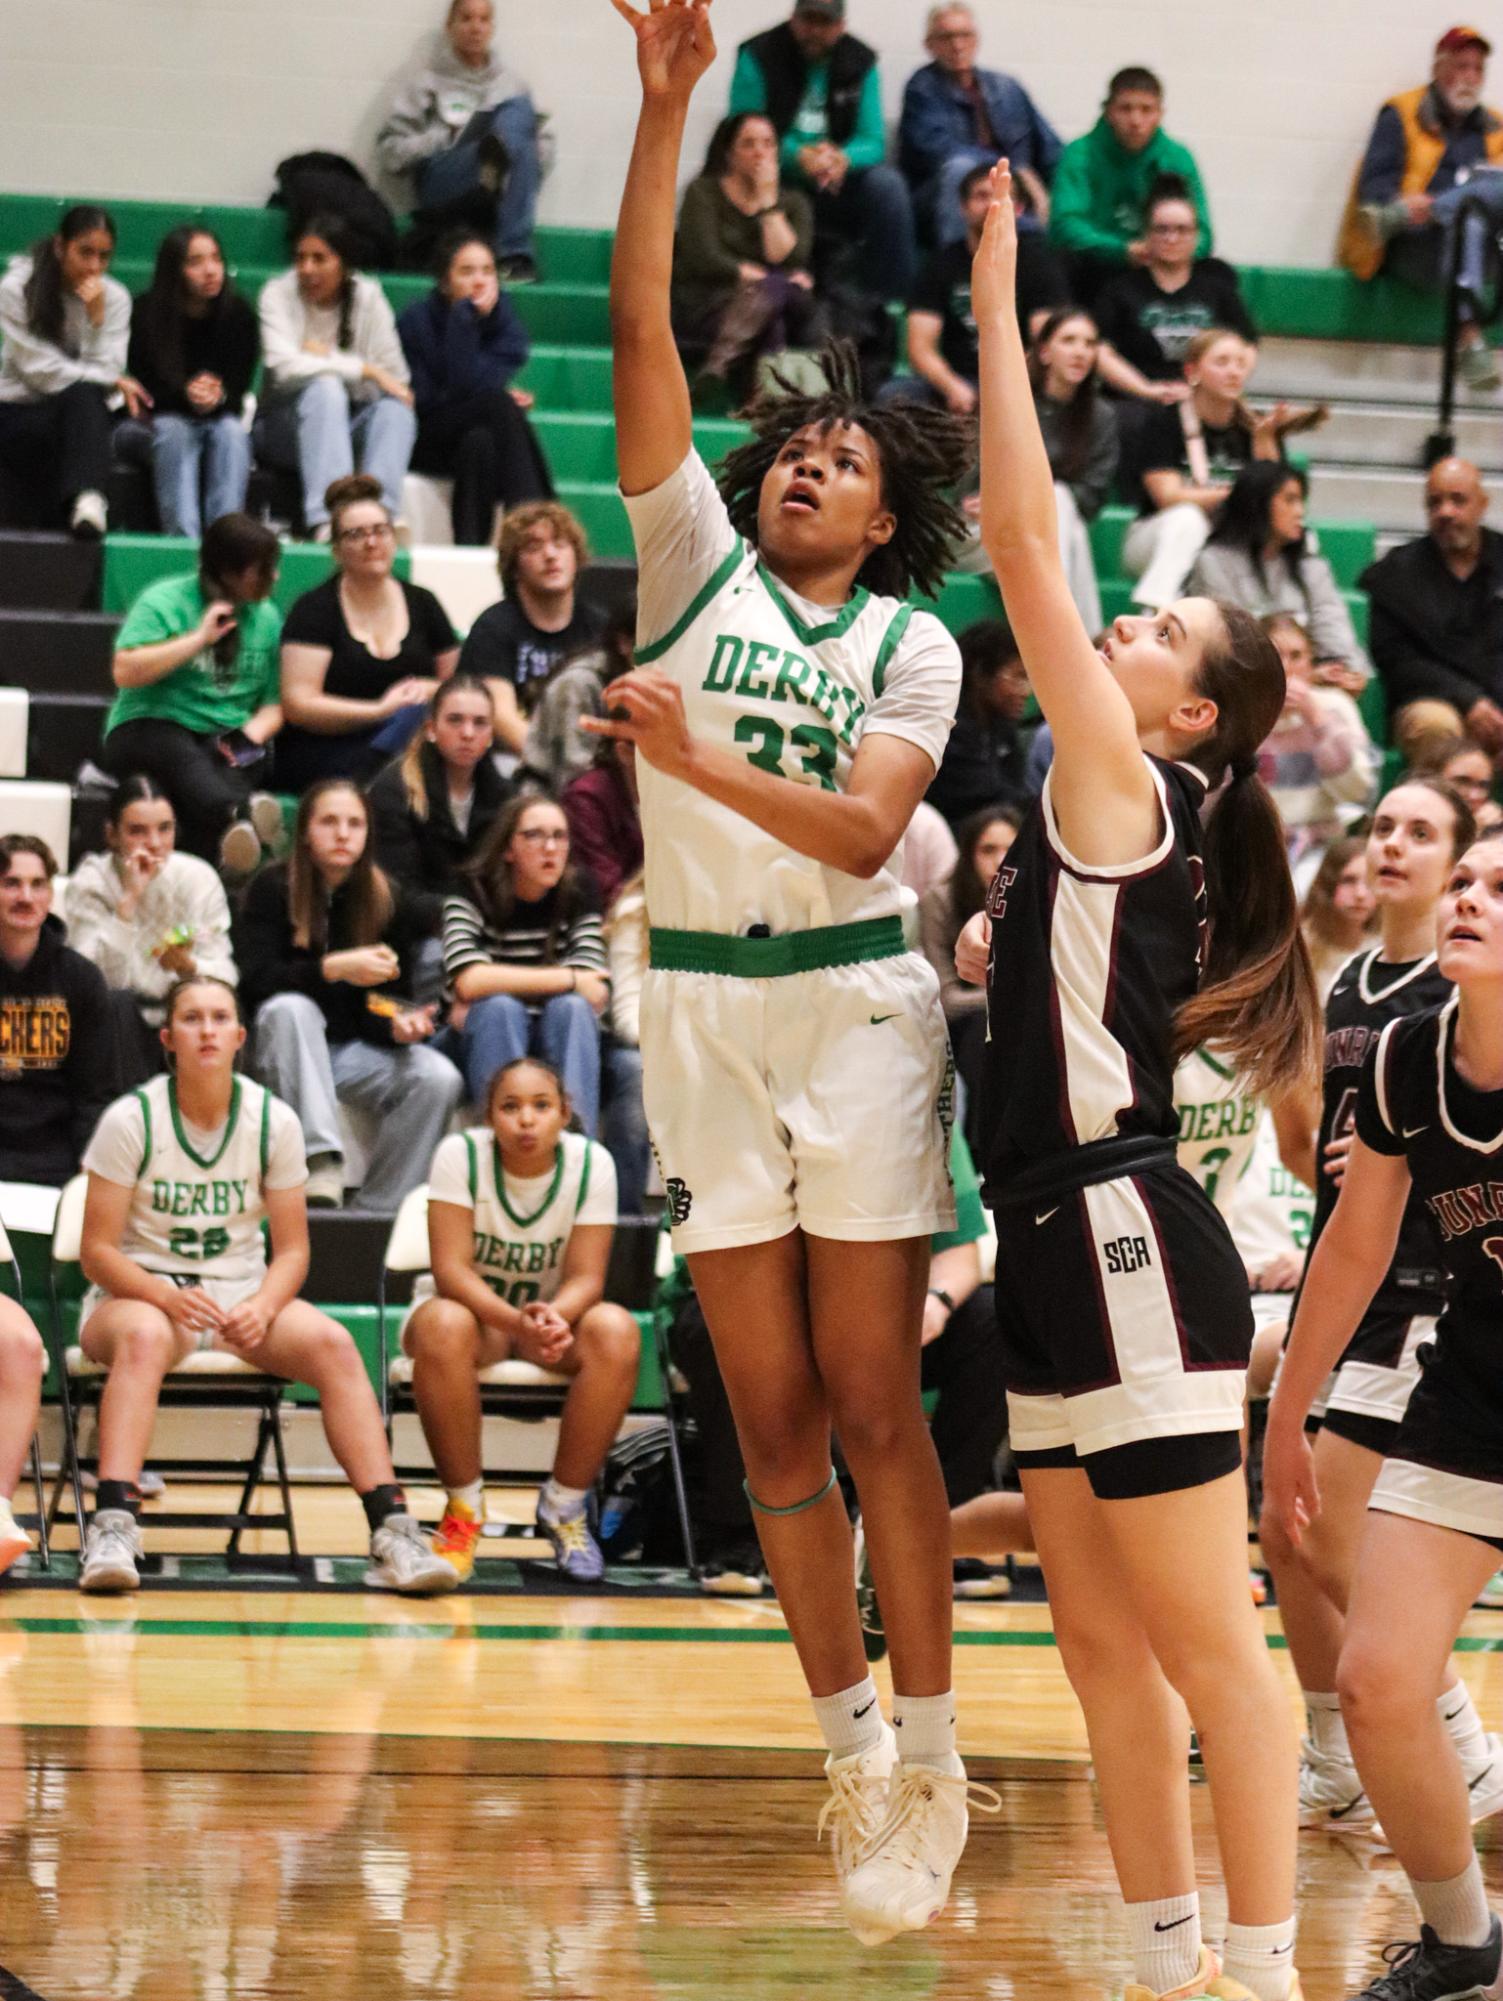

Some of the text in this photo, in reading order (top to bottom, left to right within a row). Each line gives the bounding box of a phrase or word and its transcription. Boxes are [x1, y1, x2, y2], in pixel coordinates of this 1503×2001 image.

[702, 634, 866, 747] DERBY
[1178, 1097, 1257, 1141] DERB
[152, 1180, 248, 1216] DERBY
[472, 1231, 564, 1273] DERBY
[1103, 1236, 1151, 1274] SCA
